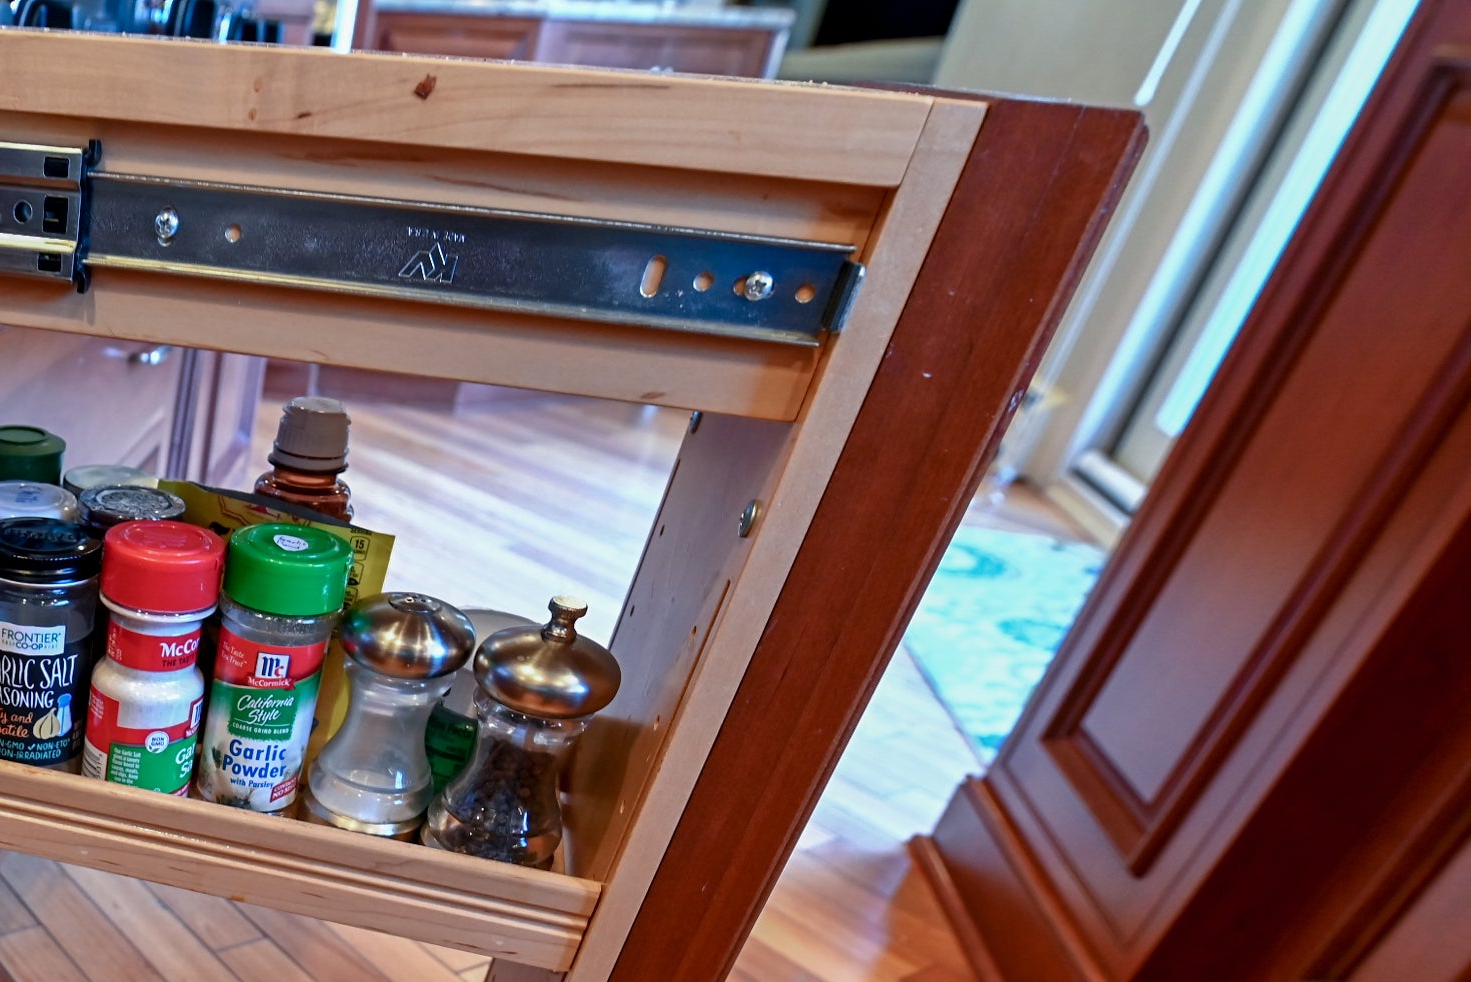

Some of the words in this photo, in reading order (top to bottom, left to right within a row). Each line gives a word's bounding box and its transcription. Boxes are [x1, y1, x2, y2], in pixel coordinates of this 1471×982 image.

[2, 628, 59, 642] FRONTIER
[16, 641, 44, 650] CO-OP
[230, 646, 244, 658] Taste
[162, 659, 178, 668] THE
[40, 654, 78, 690] SALT
[248, 676, 290, 687] McCormick
[237, 694, 294, 711] California
[10, 712, 34, 724] and
[248, 709, 280, 726] Style
[232, 722, 252, 732] COARSE
[230, 739, 286, 761] Garlic
[222, 754, 286, 778] Powder
[230, 777, 246, 787] with
[248, 780, 274, 789] Parsley
